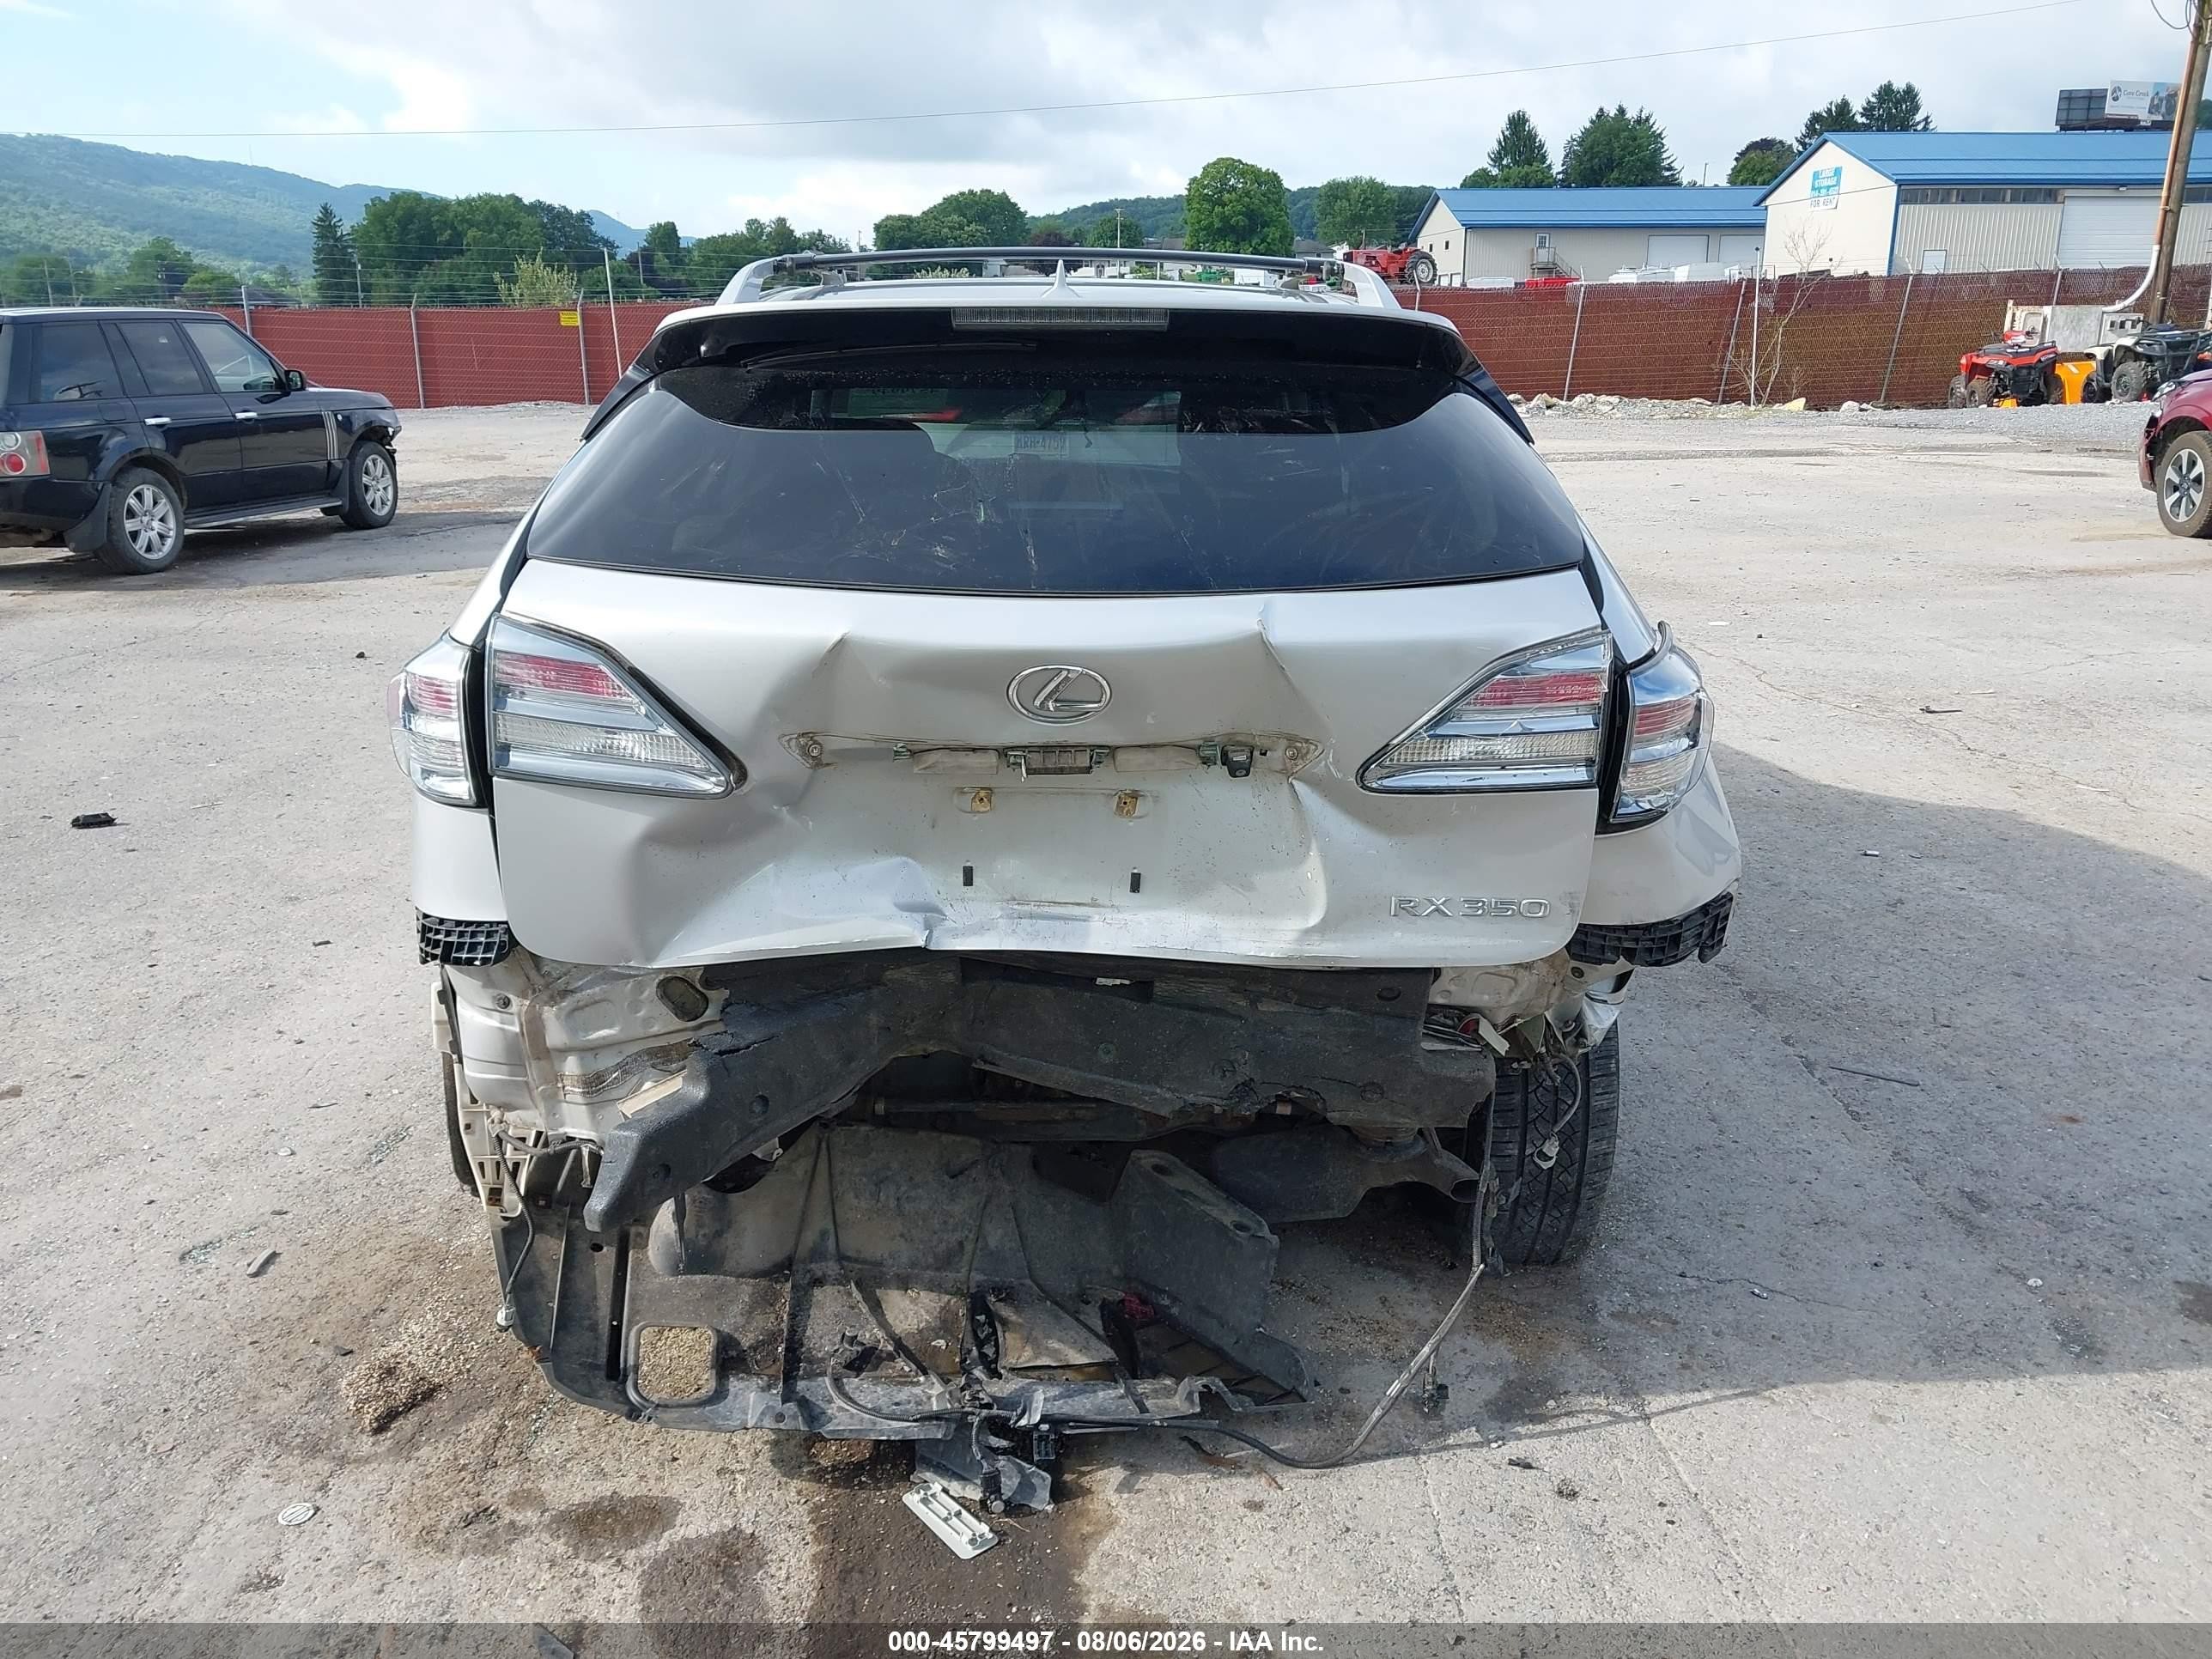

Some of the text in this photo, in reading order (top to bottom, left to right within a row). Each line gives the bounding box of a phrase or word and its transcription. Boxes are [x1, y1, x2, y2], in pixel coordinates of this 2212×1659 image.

[1814, 176, 1838, 188] STORAGE
[1810, 197, 1836, 208] FOR RENT
[1390, 896, 1552, 918] RX 350
